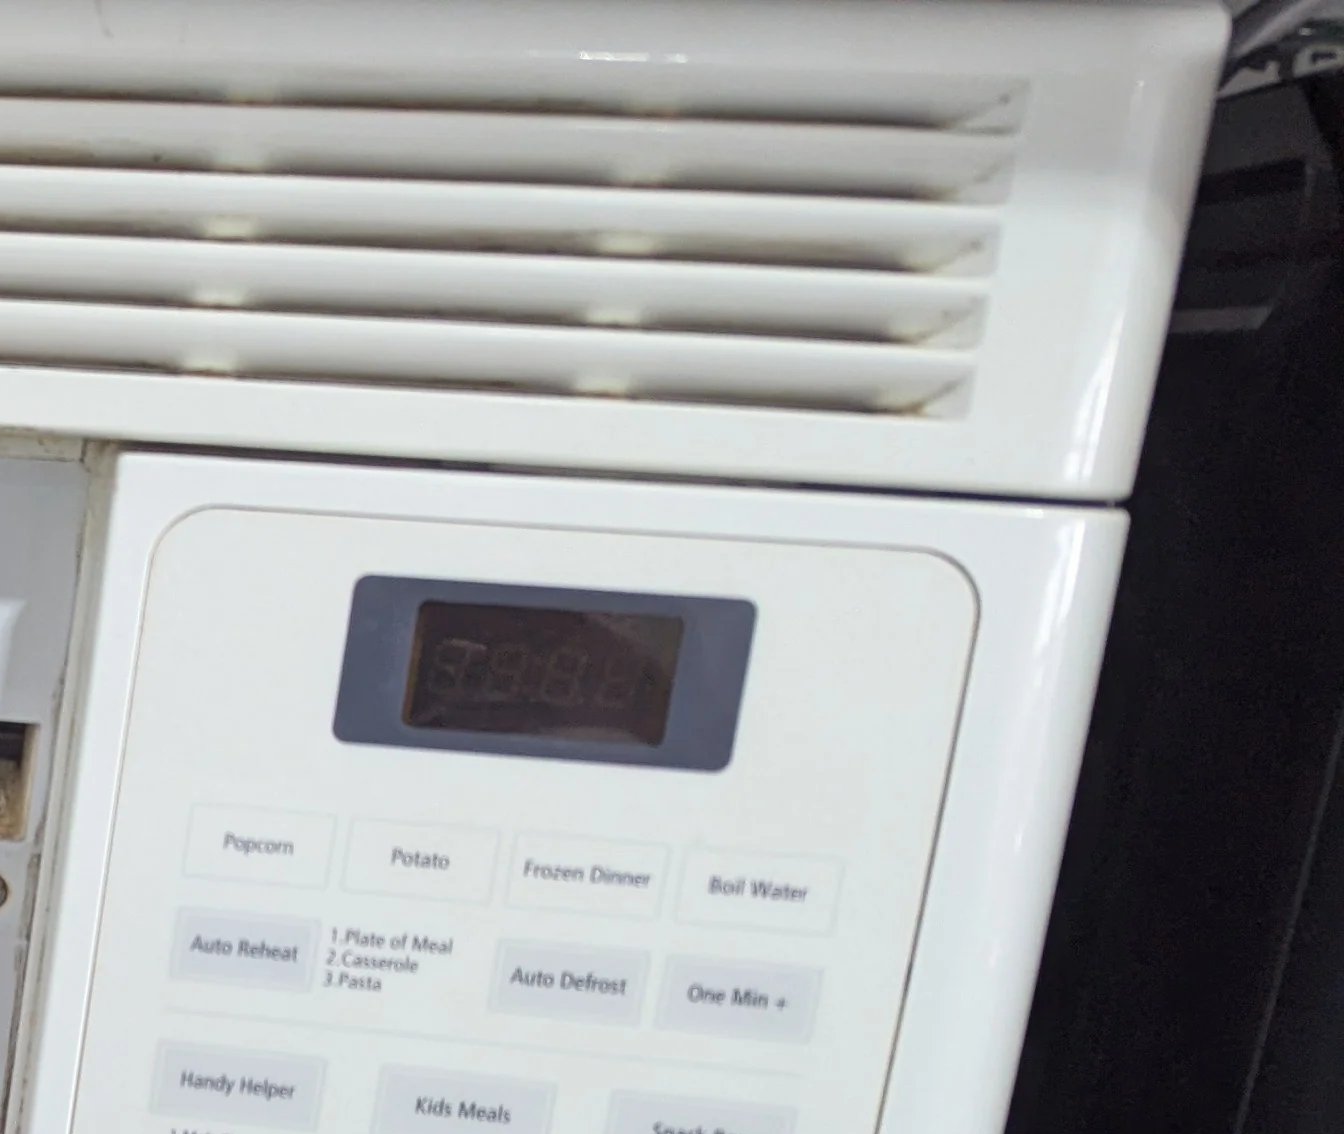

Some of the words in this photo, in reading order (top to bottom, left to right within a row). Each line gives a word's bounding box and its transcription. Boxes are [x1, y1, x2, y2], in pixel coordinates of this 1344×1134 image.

[222, 831, 295, 857] Popcorn
[390, 846, 451, 871] Potato
[522, 858, 585, 883] Frozen
[589, 864, 652, 889] Dinner
[707, 874, 745, 897] Boil
[749, 879, 809, 902] Water
[189, 933, 234, 956] Auto
[236, 938, 299, 964] Reheat
[389, 932, 409, 951] of
[410, 935, 454, 956] Meal
[509, 966, 556, 989] Auto
[559, 970, 628, 996] Defrost
[686, 983, 727, 1006] One
[730, 987, 769, 1010] Min
[179, 1070, 236, 1098] Handy
[239, 1076, 296, 1102] Helper
[414, 1095, 453, 1118] Kids
[457, 1100, 511, 1125] Meals
